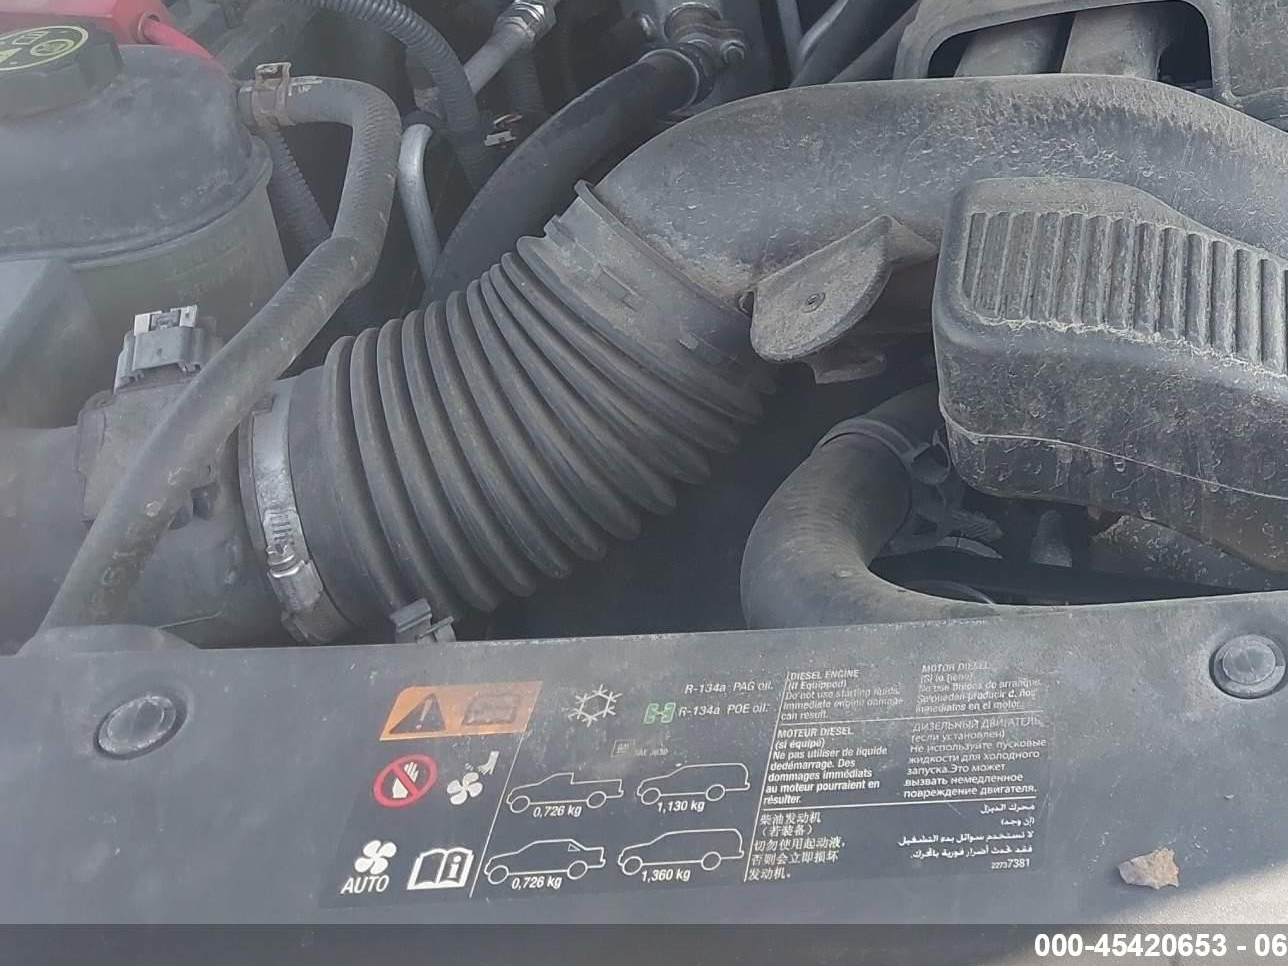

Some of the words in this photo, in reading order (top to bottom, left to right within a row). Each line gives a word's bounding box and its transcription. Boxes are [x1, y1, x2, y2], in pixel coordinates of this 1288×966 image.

[790, 671, 822, 681] DIESEL
[825, 669, 860, 679] ENGINE
[684, 683, 727, 694] R-134a
[732, 681, 755, 692] PAG
[800, 691, 815, 699] not
[818, 691, 833, 699] use
[678, 705, 721, 717] R-134a
[727, 704, 750, 714] POE
[781, 713, 797, 721] can
[777, 728, 817, 738] MOTEUR
[820, 727, 854, 736] DIESEL
[910, 745, 923, 753] Не
[996, 739, 1047, 750] пусковые
[773, 751, 785, 760] Ne
[788, 752, 805, 760] pas
[807, 749, 840, 758] utiliser
[842, 748, 854, 756] de
[856, 746, 888, 757] liquide
[909, 755, 960, 765] жидкости
[960, 754, 981, 763] для
[983, 751, 1040, 762] холодного
[838, 758, 856, 767] Des
[971, 763, 1007, 773] может
[768, 772, 820, 782] dommages
[823, 769, 872, 779] immédiats
[951, 774, 1024, 785] немедленное
[765, 785, 777, 794] au
[781, 783, 814, 793] moteur
[816, 781, 866, 792] pourraient
[867, 780, 880, 789] en
[904, 787, 978, 800] повреждение
[980, 785, 1037, 796] двигателя.
[763, 795, 801, 805] résulter.
[533, 806, 564, 818] 0,726
[567, 805, 582, 818] kg
[657, 801, 688, 814] 1,130
[690, 800, 706, 813] kg
[760, 810, 821, 825] 柴油发动机
[641, 871, 674, 883] 1,360
[676, 869, 691, 882] kg
[340, 874, 389, 894] AUTO
[511, 876, 545, 890] 0,726
[548, 876, 563, 889] kg
